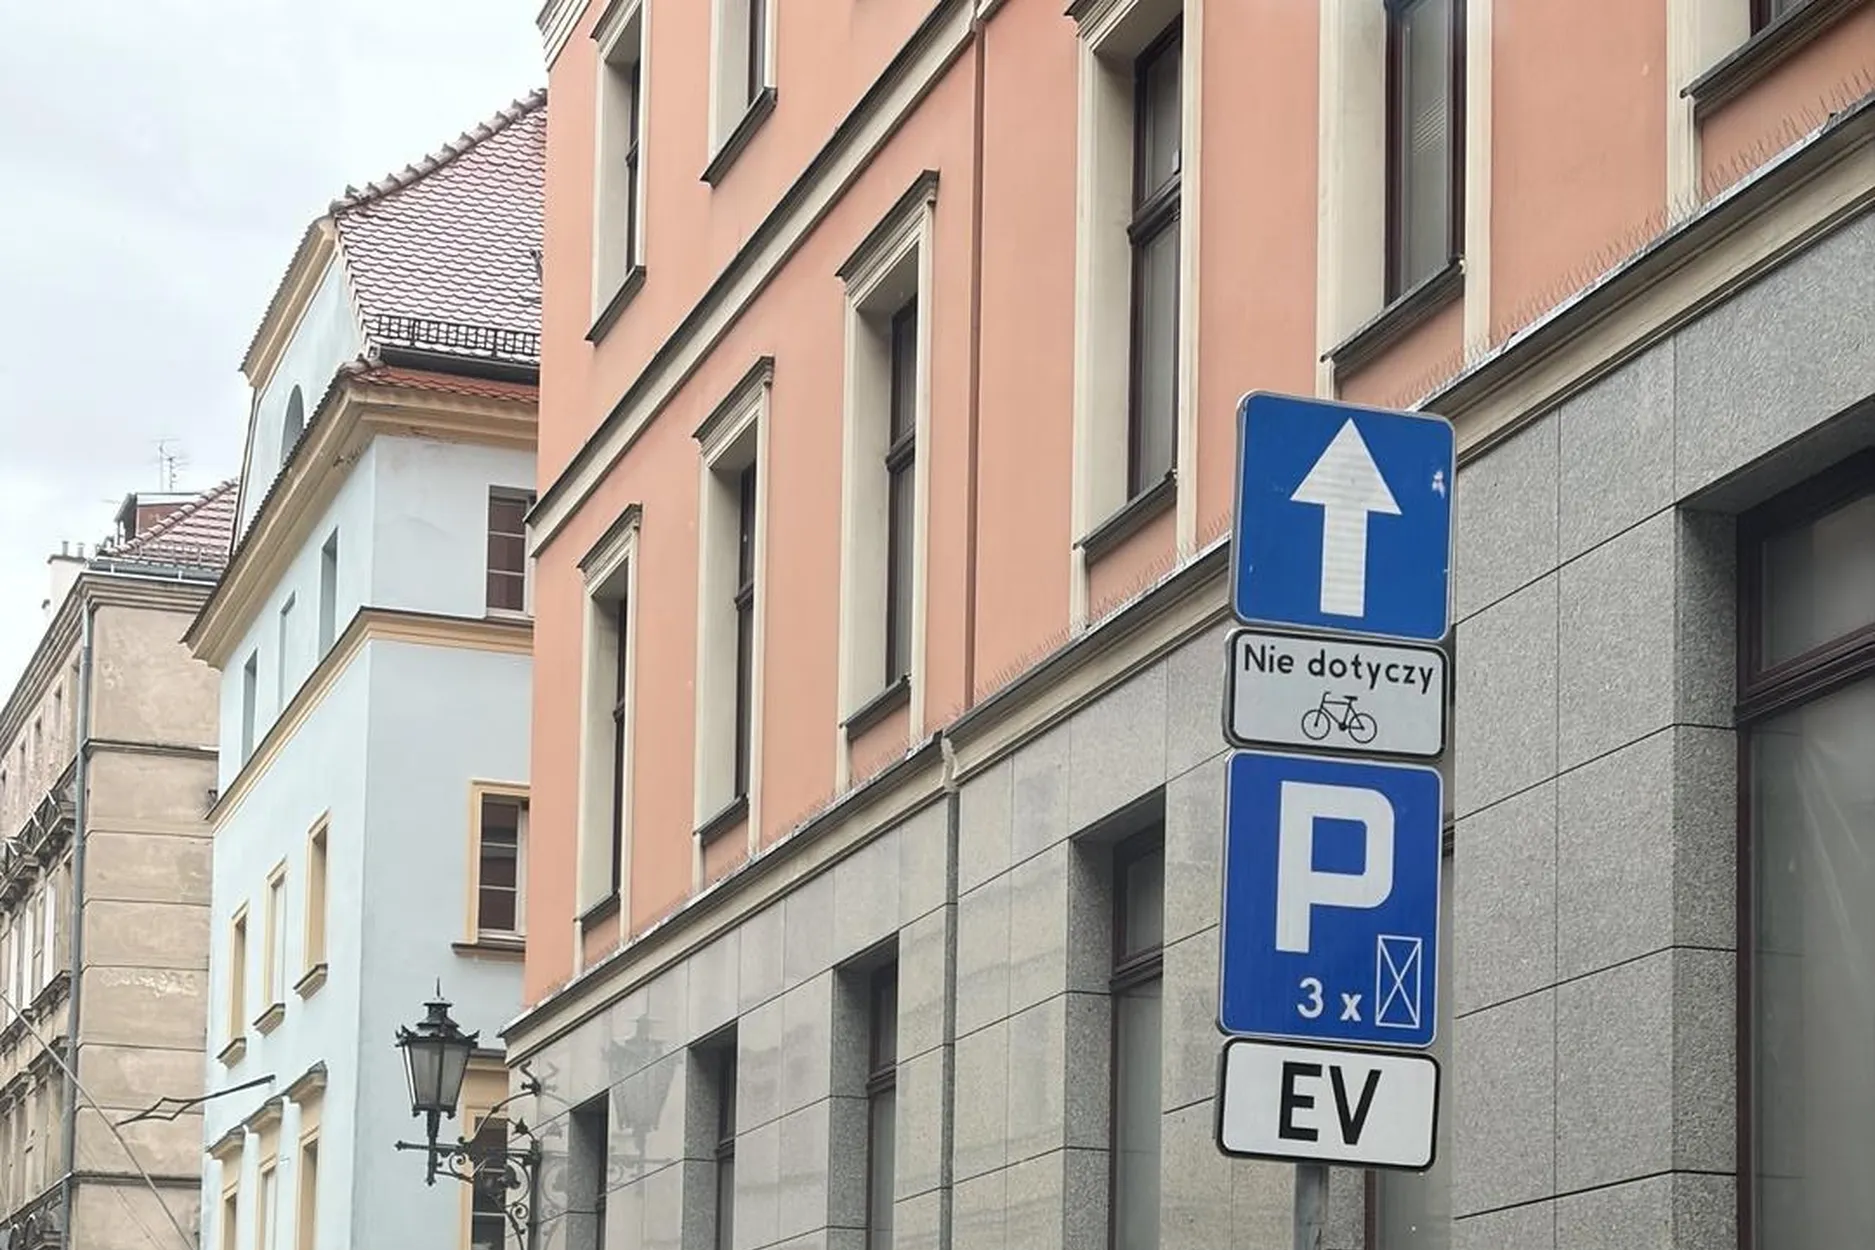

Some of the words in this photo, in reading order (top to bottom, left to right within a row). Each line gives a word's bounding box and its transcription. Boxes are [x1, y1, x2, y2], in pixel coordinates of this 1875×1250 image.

[1243, 643, 1294, 674] Nie
[1308, 649, 1434, 695] dotyczy
[1275, 780, 1395, 954] P
[1297, 976, 1324, 1019] 3
[1340, 992, 1362, 1022] x
[1278, 1061, 1382, 1146] EV
